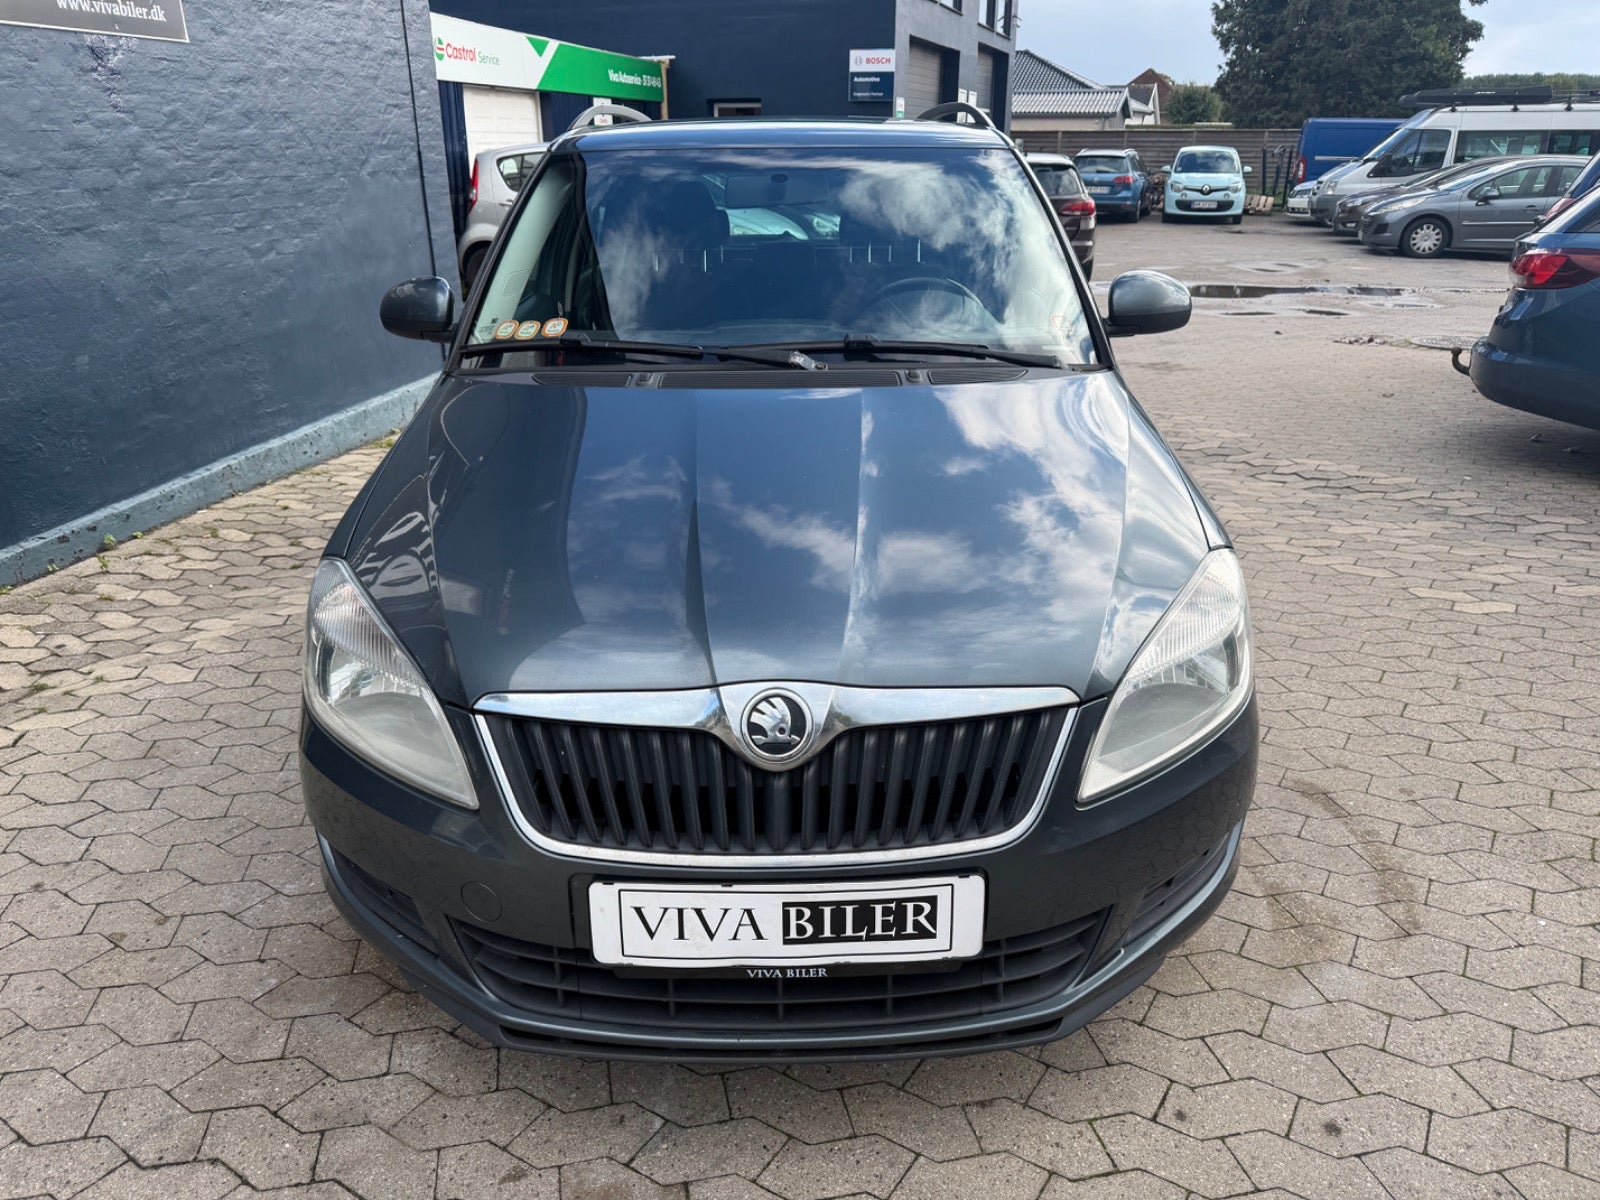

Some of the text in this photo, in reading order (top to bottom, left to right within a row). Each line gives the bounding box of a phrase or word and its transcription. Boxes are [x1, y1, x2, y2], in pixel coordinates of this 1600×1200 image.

[57, 0, 166, 21] www.vivabiler.dk
[445, 43, 500, 65] Castrol Service
[630, 901, 937, 941] VIVA BILER
[746, 967, 828, 978] VIVA BILER
